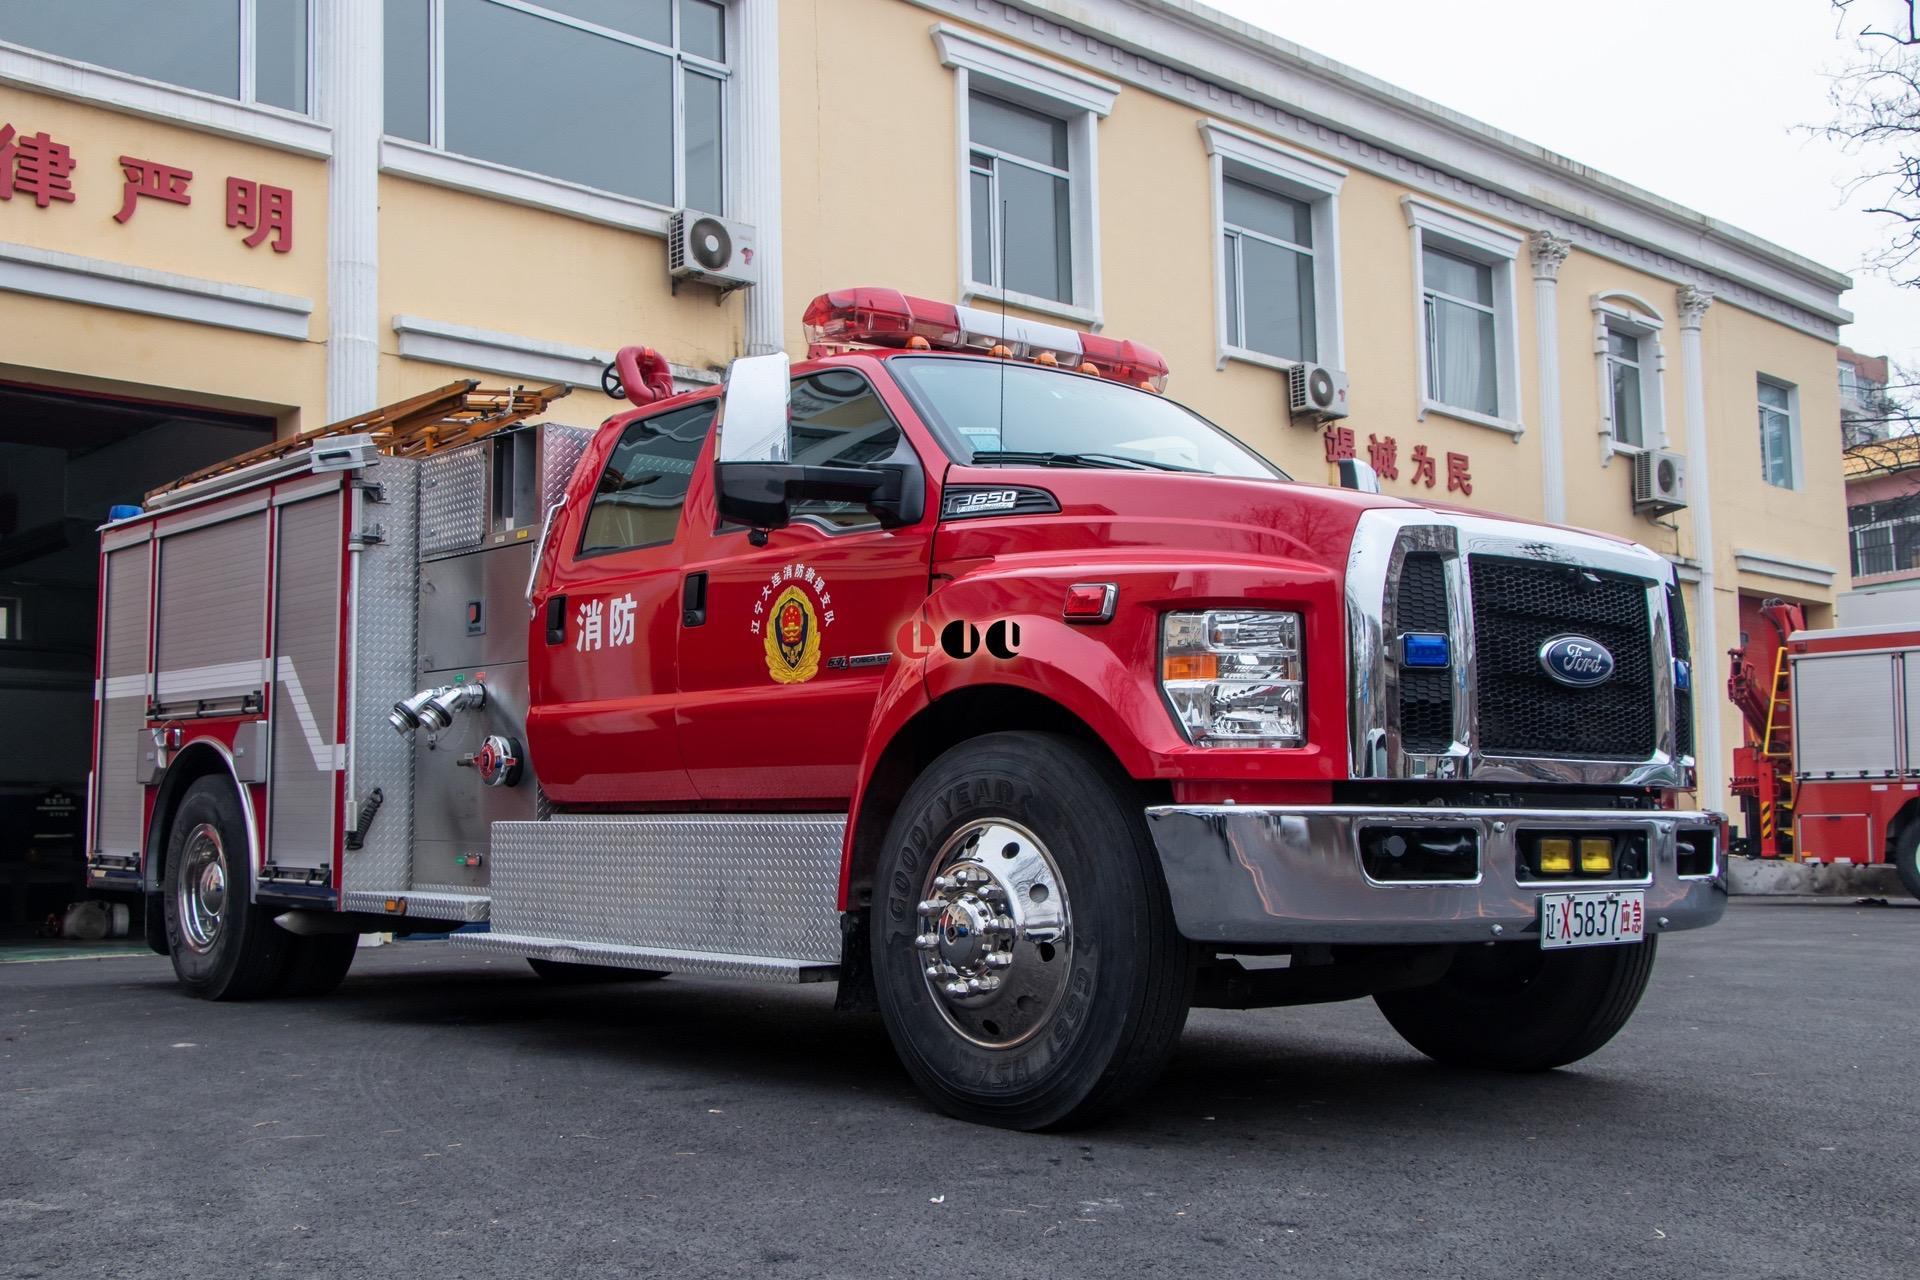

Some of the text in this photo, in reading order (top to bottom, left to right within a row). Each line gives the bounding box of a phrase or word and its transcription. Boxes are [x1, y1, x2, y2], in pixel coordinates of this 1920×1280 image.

[0, 123, 293, 253] 律严明
[1324, 425, 1473, 496] 竭诚为民
[576, 592, 638, 652] 消防
[750, 563, 835, 634] 辽宁大连消防救援支队
[1563, 643, 1602, 673] Ford
[889, 777, 1015, 923] GOODYEAR
